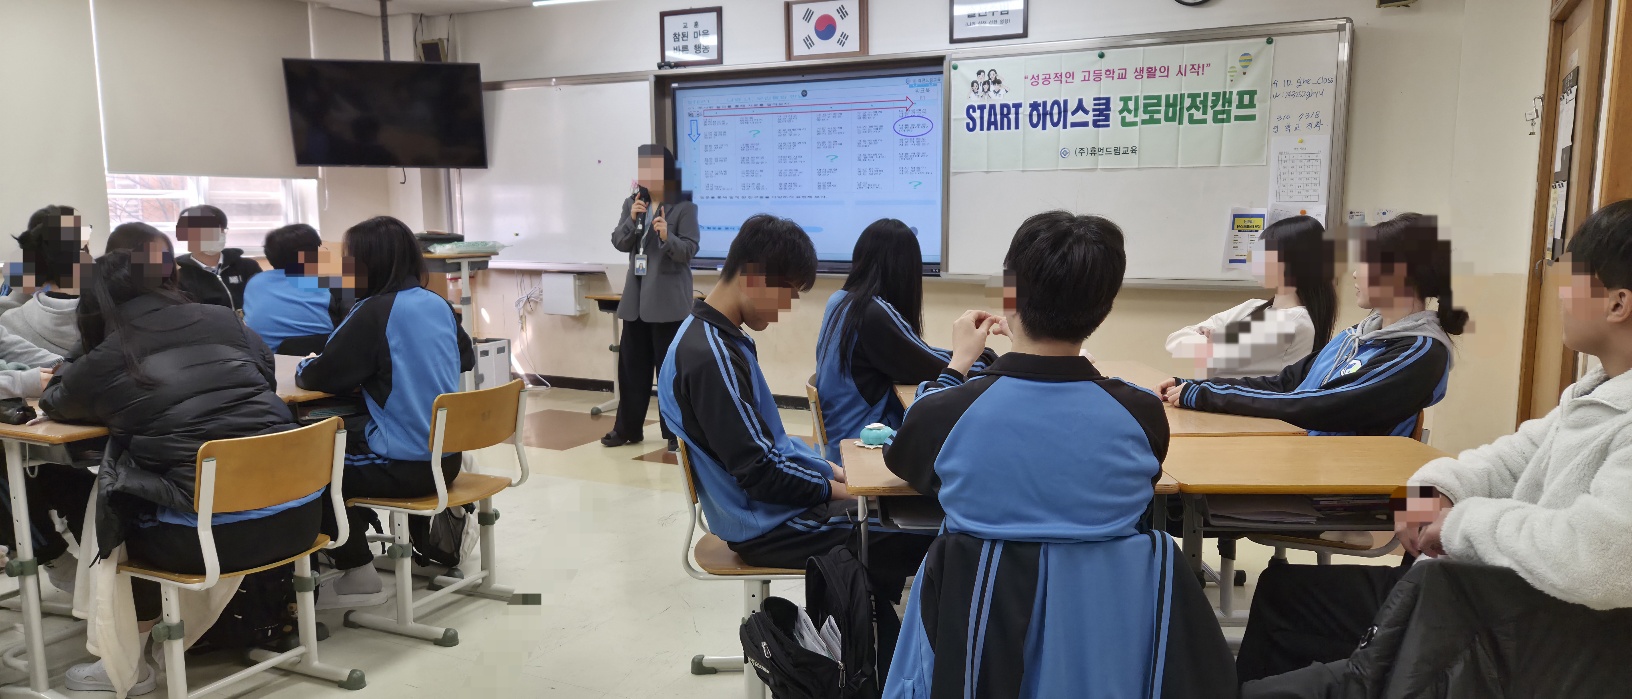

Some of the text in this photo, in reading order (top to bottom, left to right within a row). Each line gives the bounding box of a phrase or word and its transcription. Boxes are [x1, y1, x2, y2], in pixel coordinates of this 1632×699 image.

[672, 31, 689, 43] 참된
[1081, 67, 1127, 82] 고등학교
[1133, 65, 1170, 80] 생활의
[965, 102, 1023, 133] START
[1028, 96, 1112, 131] 하이스쿨
[1118, 89, 1258, 128] 진로비전캠프
[1074, 145, 1138, 157] (주)휴먼드림교육
